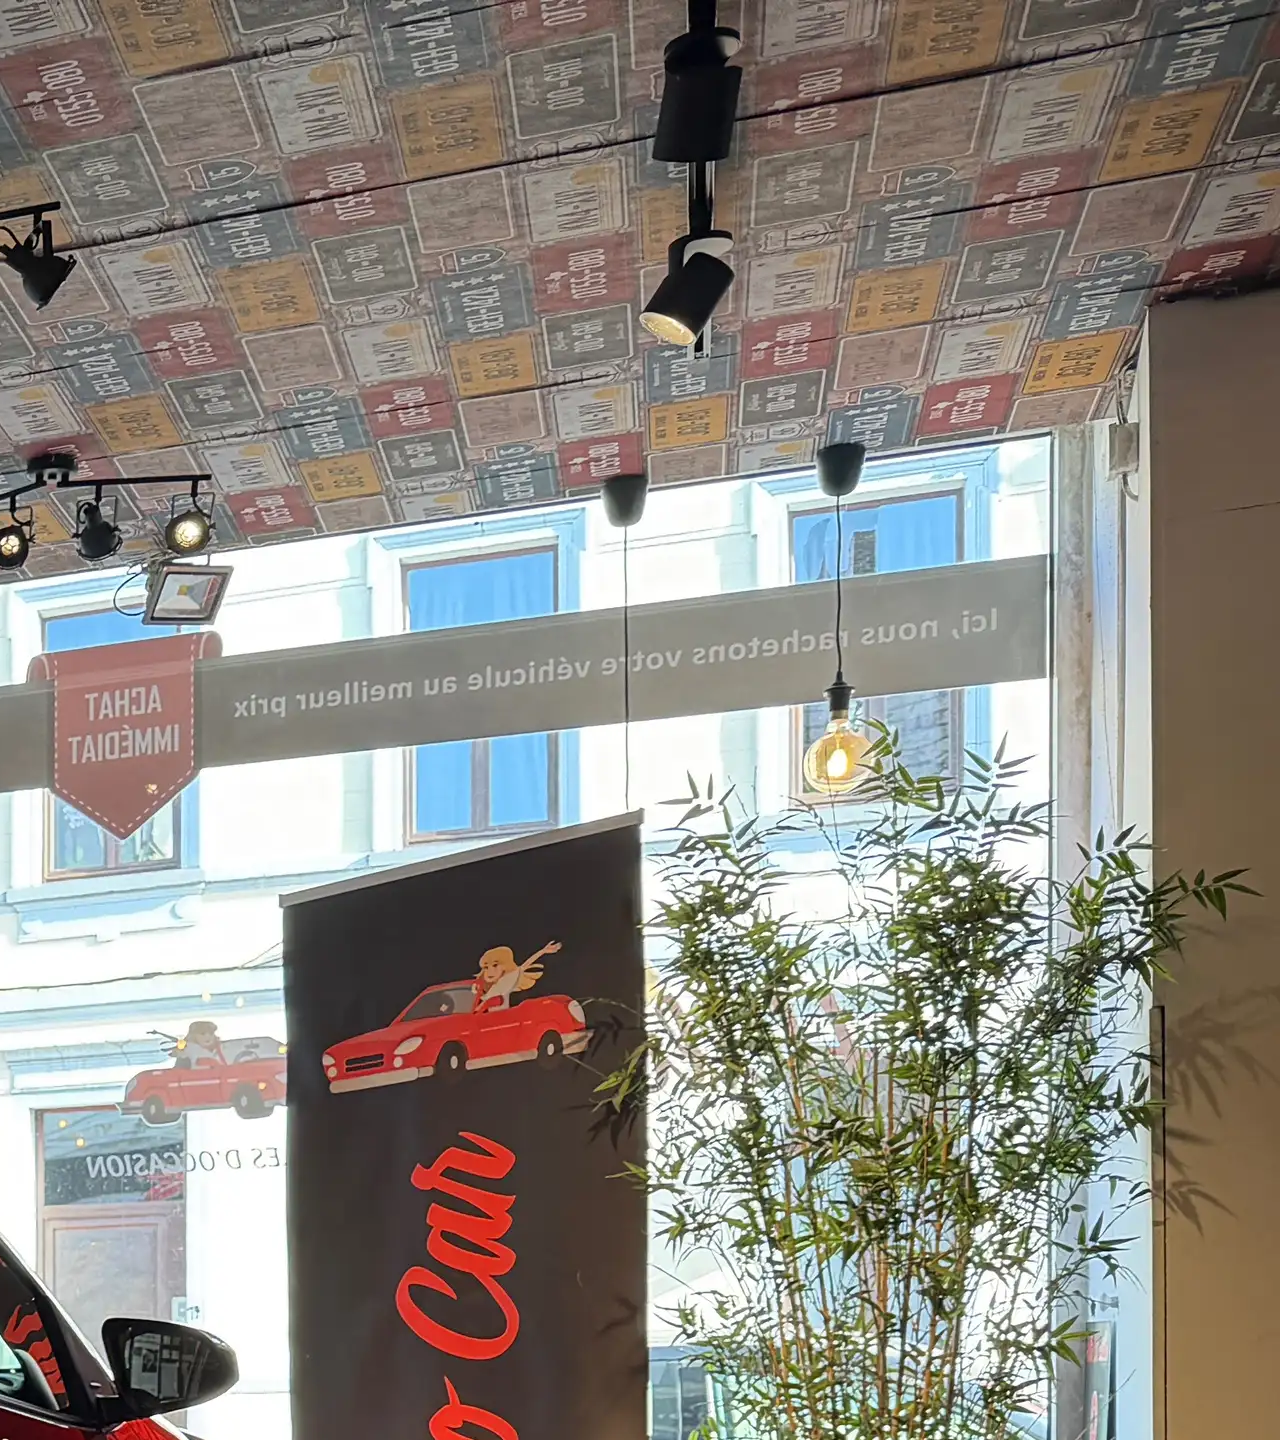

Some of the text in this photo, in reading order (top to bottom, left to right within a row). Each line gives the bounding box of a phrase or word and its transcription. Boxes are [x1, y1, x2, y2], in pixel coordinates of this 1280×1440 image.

[207, 165, 242, 181] 15
[903, 171, 939, 186] 15
[459, 252, 491, 265] 15
[395, 1131, 521, 1361] Car
